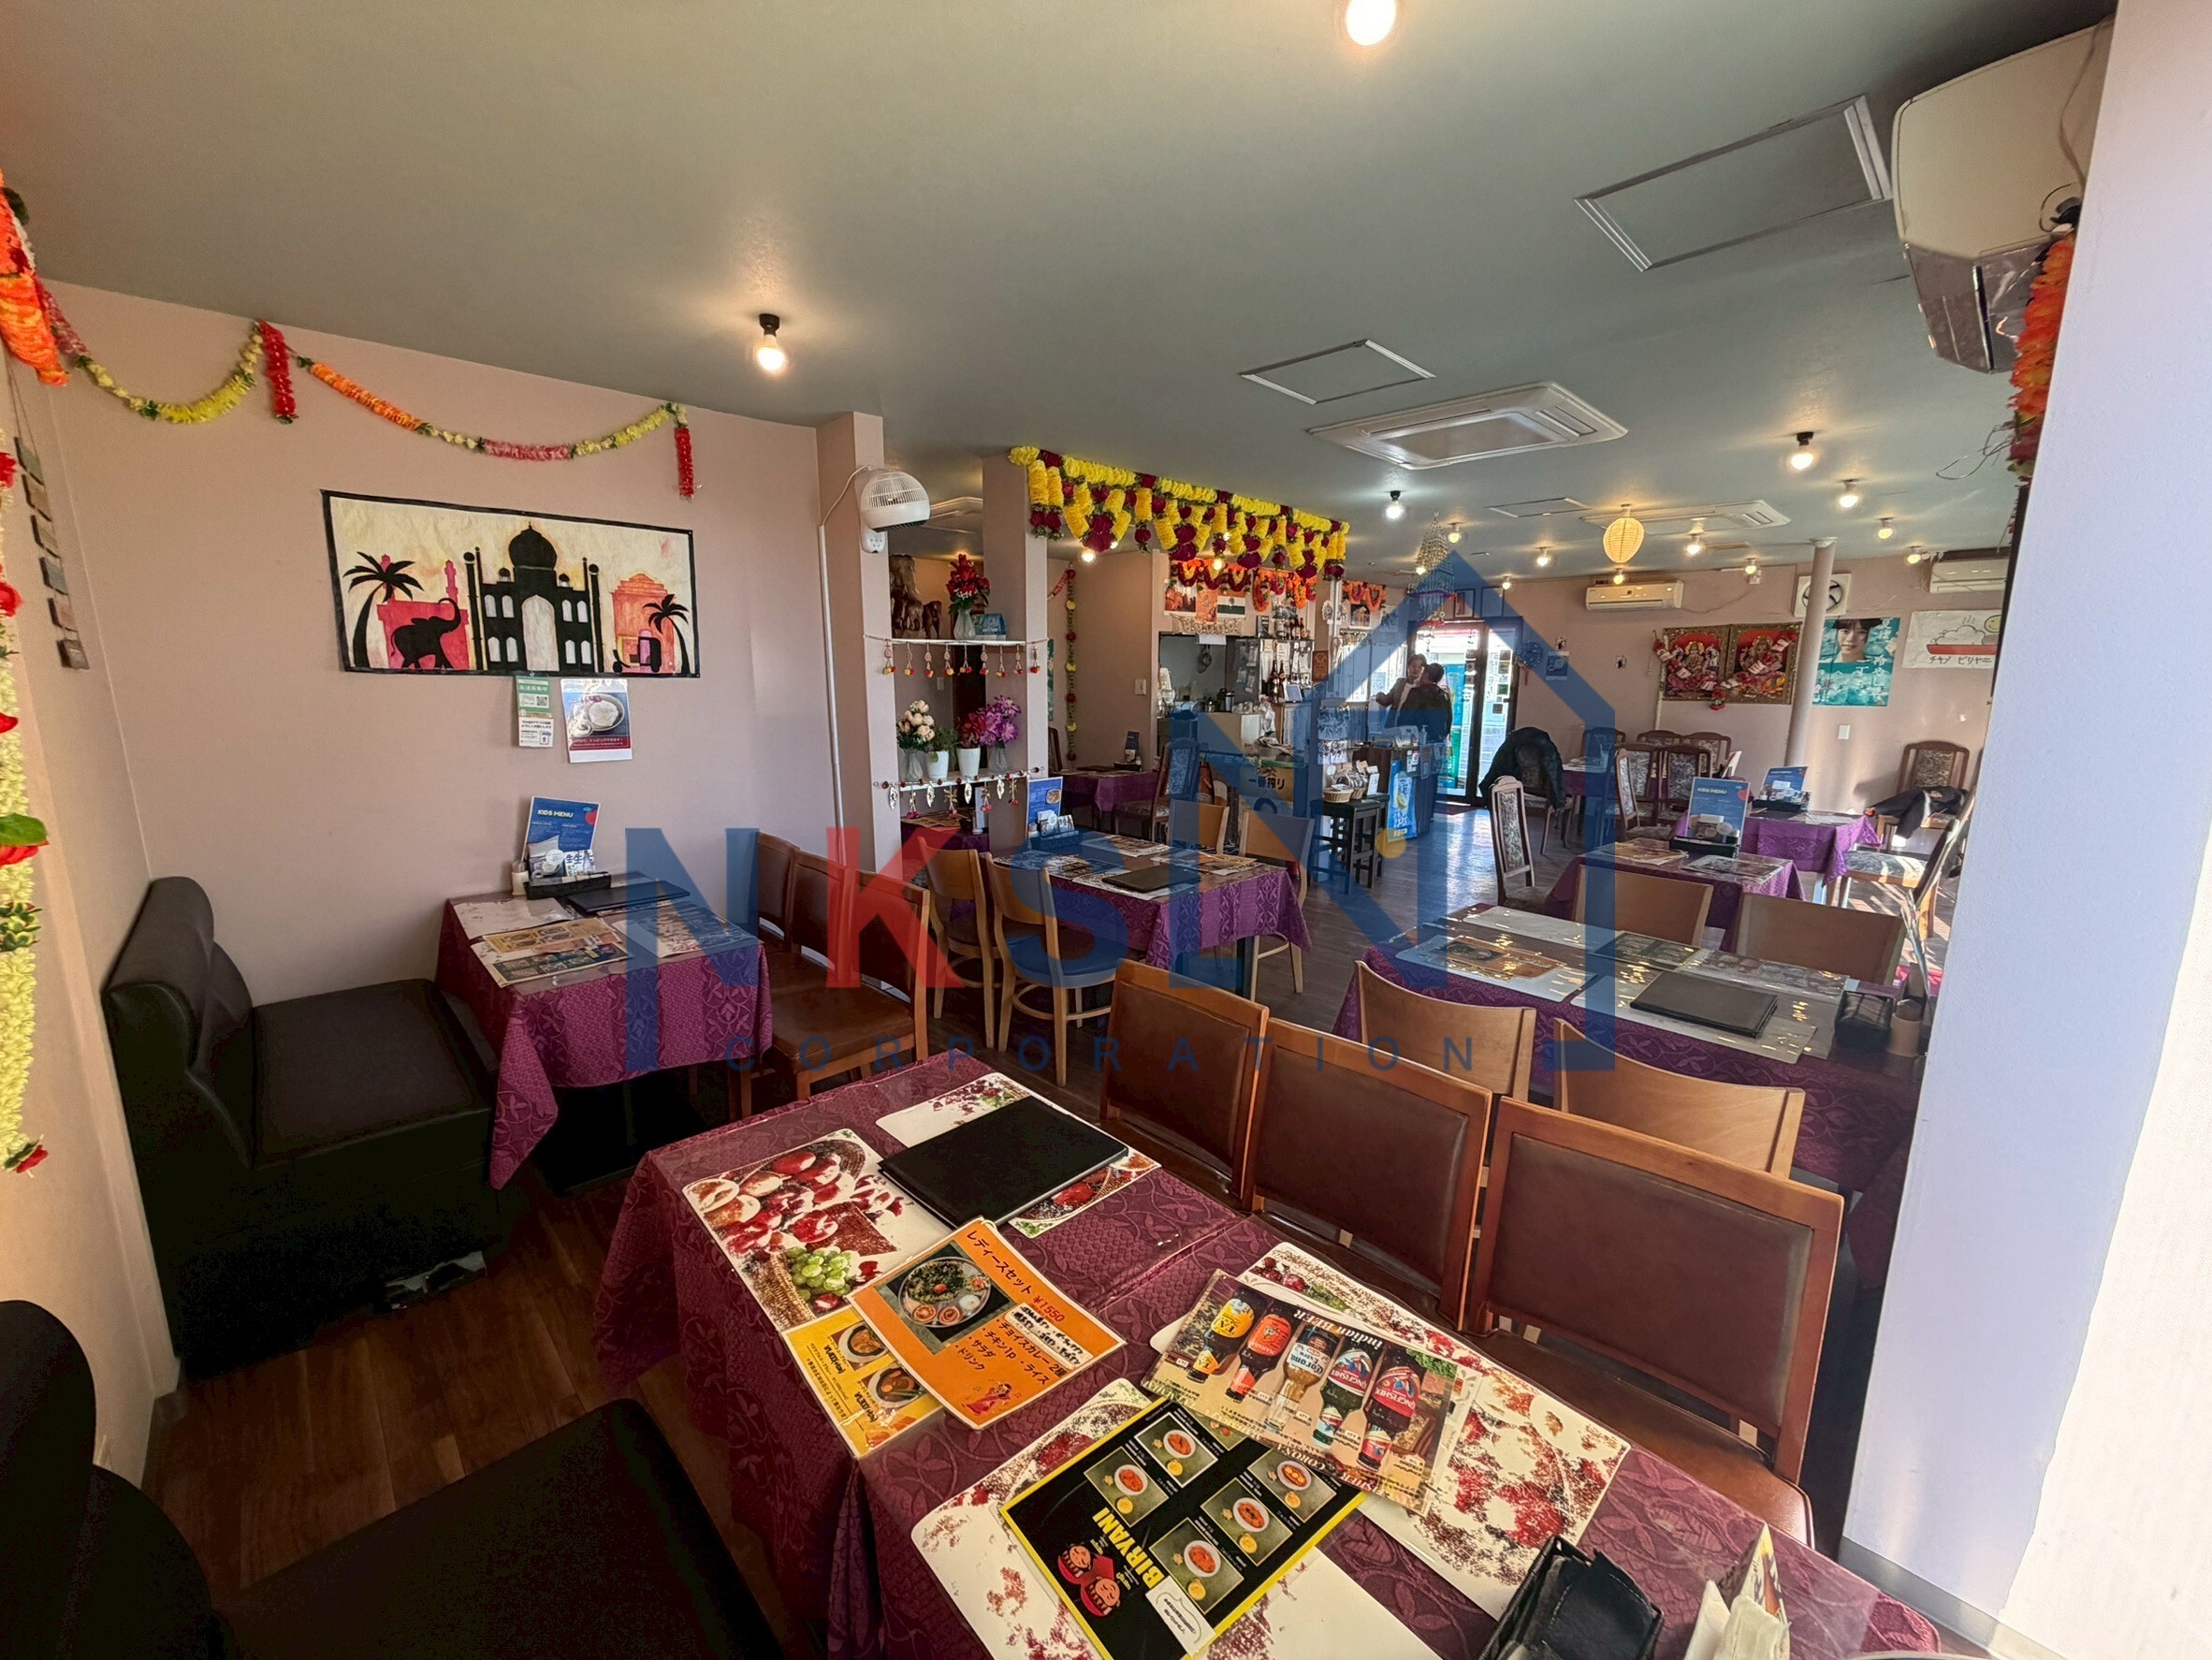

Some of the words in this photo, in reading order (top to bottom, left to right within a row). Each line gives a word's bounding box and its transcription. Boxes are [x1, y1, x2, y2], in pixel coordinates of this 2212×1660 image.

[1248, 776, 1285, 790] 一番搾り
[967, 1230, 1034, 1295] レディースセット
[1032, 1295, 1066, 1323] ¥1550
[1292, 1308, 1334, 1331] BEER
[1336, 1326, 1383, 1350] indian
[1288, 1353, 1324, 1376] Corona
[1092, 1507, 1164, 1588] BIRYANI
